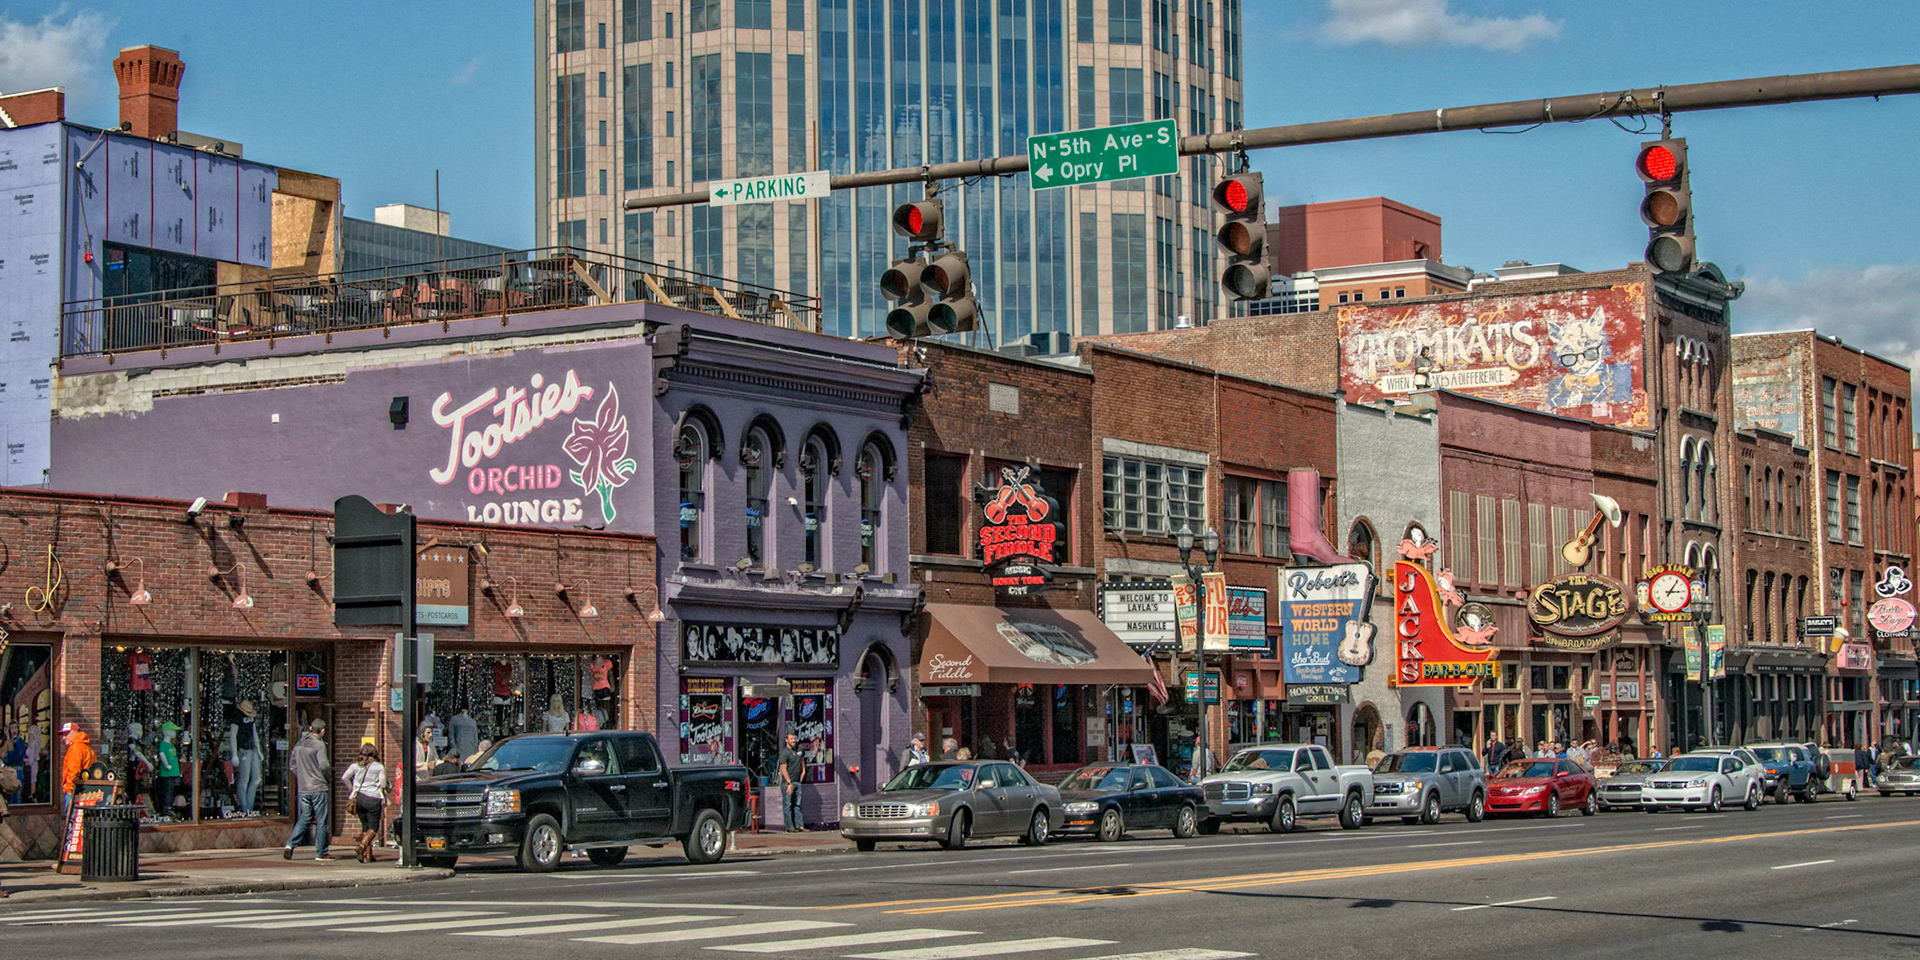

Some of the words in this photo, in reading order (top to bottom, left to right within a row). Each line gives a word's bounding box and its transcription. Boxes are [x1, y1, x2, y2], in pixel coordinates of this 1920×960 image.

[1033, 139, 1090, 161] N-5th
[1102, 128, 1170, 151] Ave-S
[1060, 159, 1104, 182] Opry
[733, 177, 806, 200] PARKING
[1357, 318, 1540, 381] TOMKATS
[1386, 377, 1410, 391] WHEN
[1429, 373, 1450, 388] AKES
[1451, 372, 1459, 387] A
[1458, 369, 1505, 386] DIFFERENCE
[429, 369, 595, 486] Tootsies
[468, 465, 562, 495] ORCHID
[467, 498, 584, 525] LOUNGE
[1007, 514, 1028, 525] THE
[980, 523, 1057, 546] SECOND
[983, 540, 1053, 565] FIDDLE
[1004, 566, 1032, 575] MUSIC
[1646, 565, 1665, 579] BIG
[1666, 563, 1694, 578] TIME
[992, 577, 1020, 586] HONKY
[1021, 576, 1045, 585] TONK
[1287, 570, 1360, 600] Robert's
[1568, 576, 1588, 585] THE
[1119, 594, 1155, 603] WELCOME
[1158, 593, 1169, 602] TO
[1534, 583, 1628, 625] STAGE
[1127, 604, 1159, 612] LAYLA'S
[1290, 603, 1355, 617] WESTERN
[427, 611, 459, 620] POSTCARDS
[1650, 612, 1692, 622] BOOTS
[1127, 622, 1167, 631] NASHVILLE
[1291, 618, 1339, 632] WORLD
[1398, 571, 1425, 683] JACKS
[1292, 633, 1330, 647] HOME
[1875, 629, 1909, 639] CLOTHING
[1545, 636, 1558, 646] ON
[1561, 636, 1612, 648] BROADWAY
[1305, 645, 1313, 656] of
[929, 653, 973, 668] Second
[1291, 652, 1331, 665] Sho-Bud
[929, 666, 973, 680] Fiddle
[1423, 663, 1494, 679] BAR-B-QUE
[297, 676, 318, 688] OPEN
[945, 688, 967, 696] ATM
[1289, 685, 1321, 697] HONKY
[1322, 686, 1347, 697] TONK
[1306, 695, 1330, 703] GRILL
[690, 721, 723, 746] Tootsies
[70, 808, 84, 852] EGENDS
